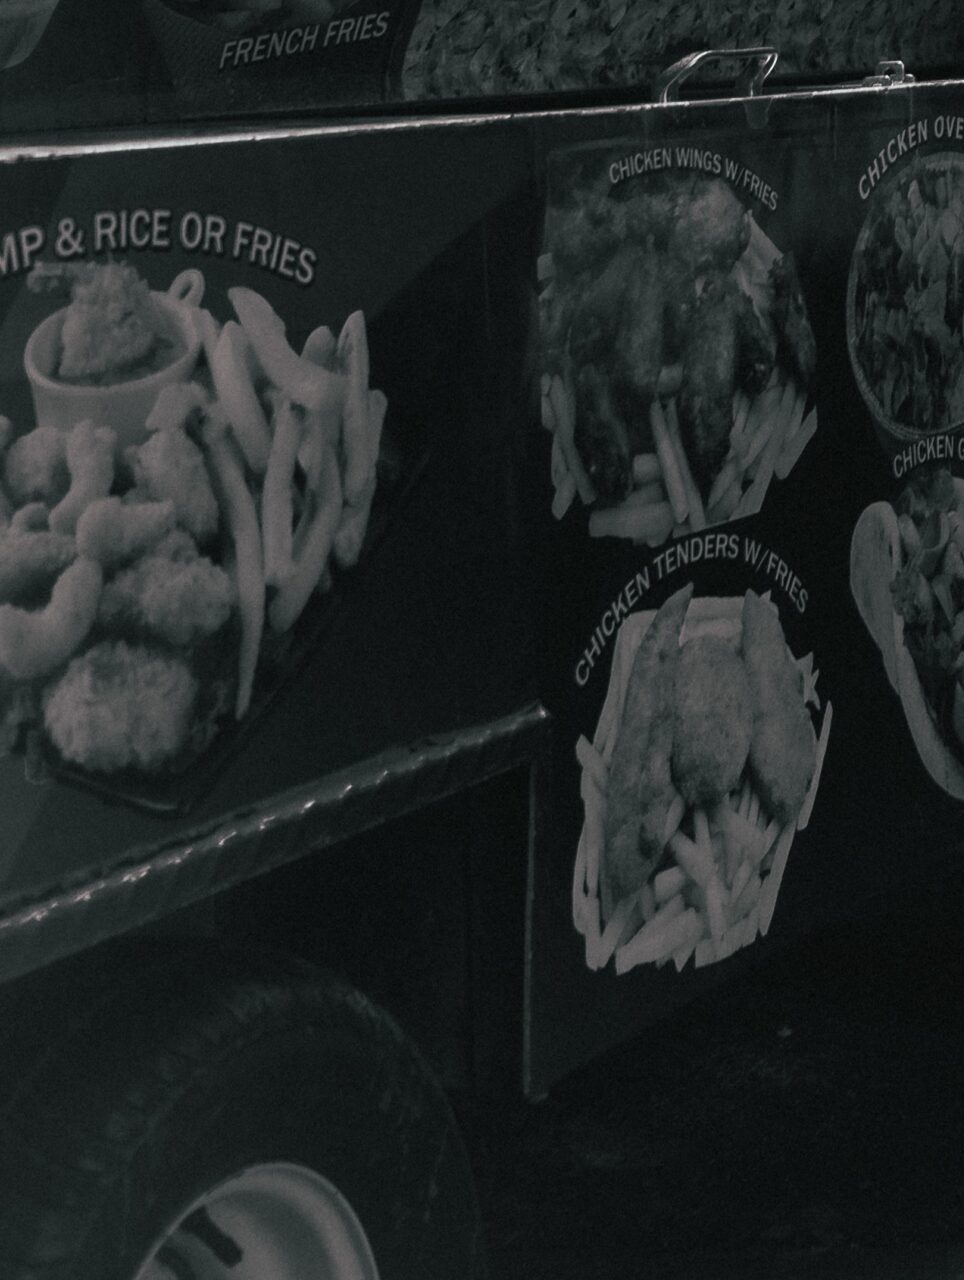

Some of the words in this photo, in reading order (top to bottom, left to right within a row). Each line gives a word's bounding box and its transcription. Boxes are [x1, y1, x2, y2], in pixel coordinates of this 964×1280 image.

[219, 23, 321, 69] FRENCH
[323, 11, 391, 48] FRIES
[608, 147, 672, 184] CHICKEN
[675, 147, 722, 174] WINGS
[725, 157, 778, 211] W/FRIES
[858, 119, 928, 200] CHICKEN
[55, 217, 86, 257] &
[94, 209, 171, 251] RICE
[179, 211, 227, 253] OR
[233, 221, 318, 284] FRIES
[893, 434, 954, 479] CHICKEN
[575, 566, 651, 686] CHICKEN
[652, 533, 740, 580] TENDERS
[744, 537, 809, 614] W/FRIES
